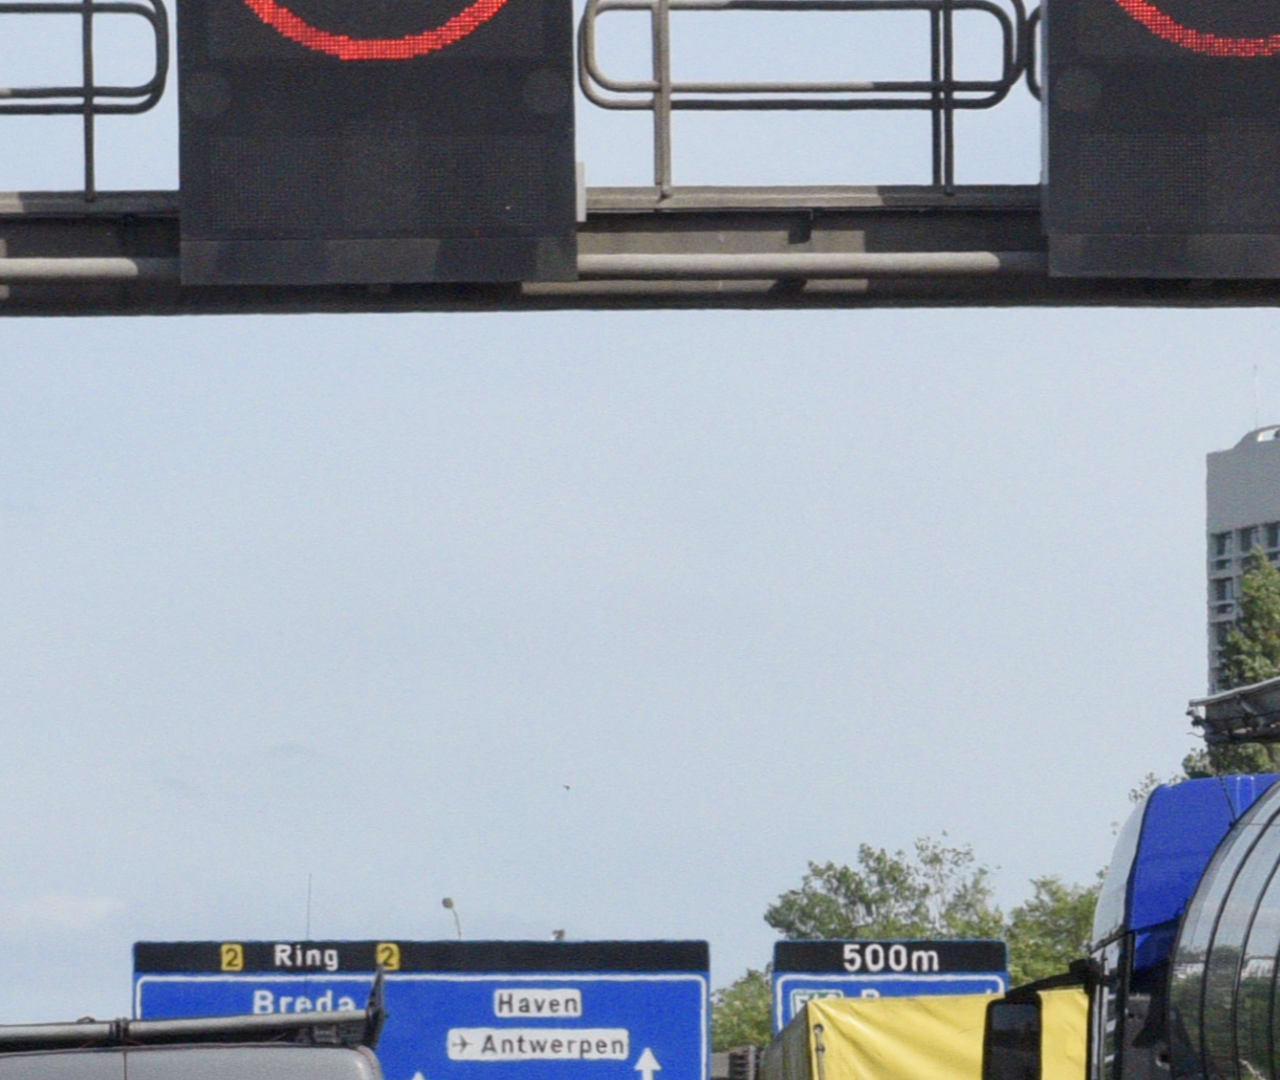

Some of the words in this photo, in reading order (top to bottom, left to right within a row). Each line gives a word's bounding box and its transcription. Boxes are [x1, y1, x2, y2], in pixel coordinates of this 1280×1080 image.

[225, 948, 238, 968] 2
[274, 944, 339, 971] Ring
[843, 944, 939, 971] 500m
[253, 989, 356, 1014] Breda
[498, 994, 578, 1013] Haven
[481, 1035, 625, 1059] Antwerpen
